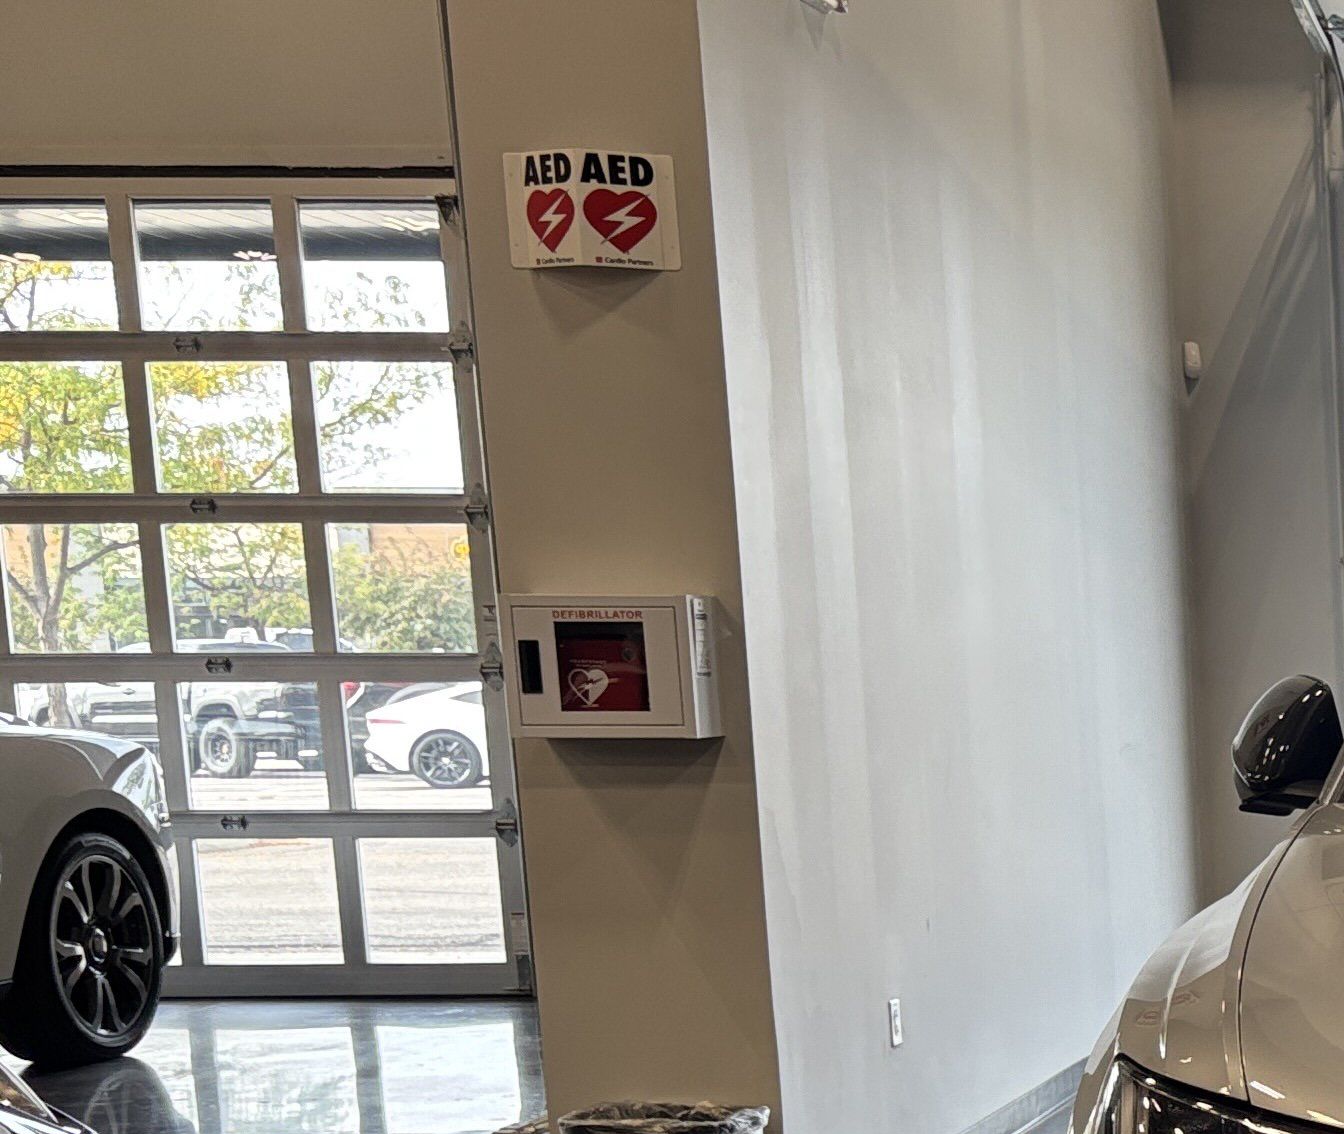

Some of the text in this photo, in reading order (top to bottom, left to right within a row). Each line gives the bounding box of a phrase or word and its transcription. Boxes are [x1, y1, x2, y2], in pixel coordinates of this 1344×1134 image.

[524, 152, 572, 187] AED
[580, 152, 654, 187] AED
[604, 257, 654, 266] Cardio Partners
[552, 610, 643, 620] DEFIBRILLATOR
